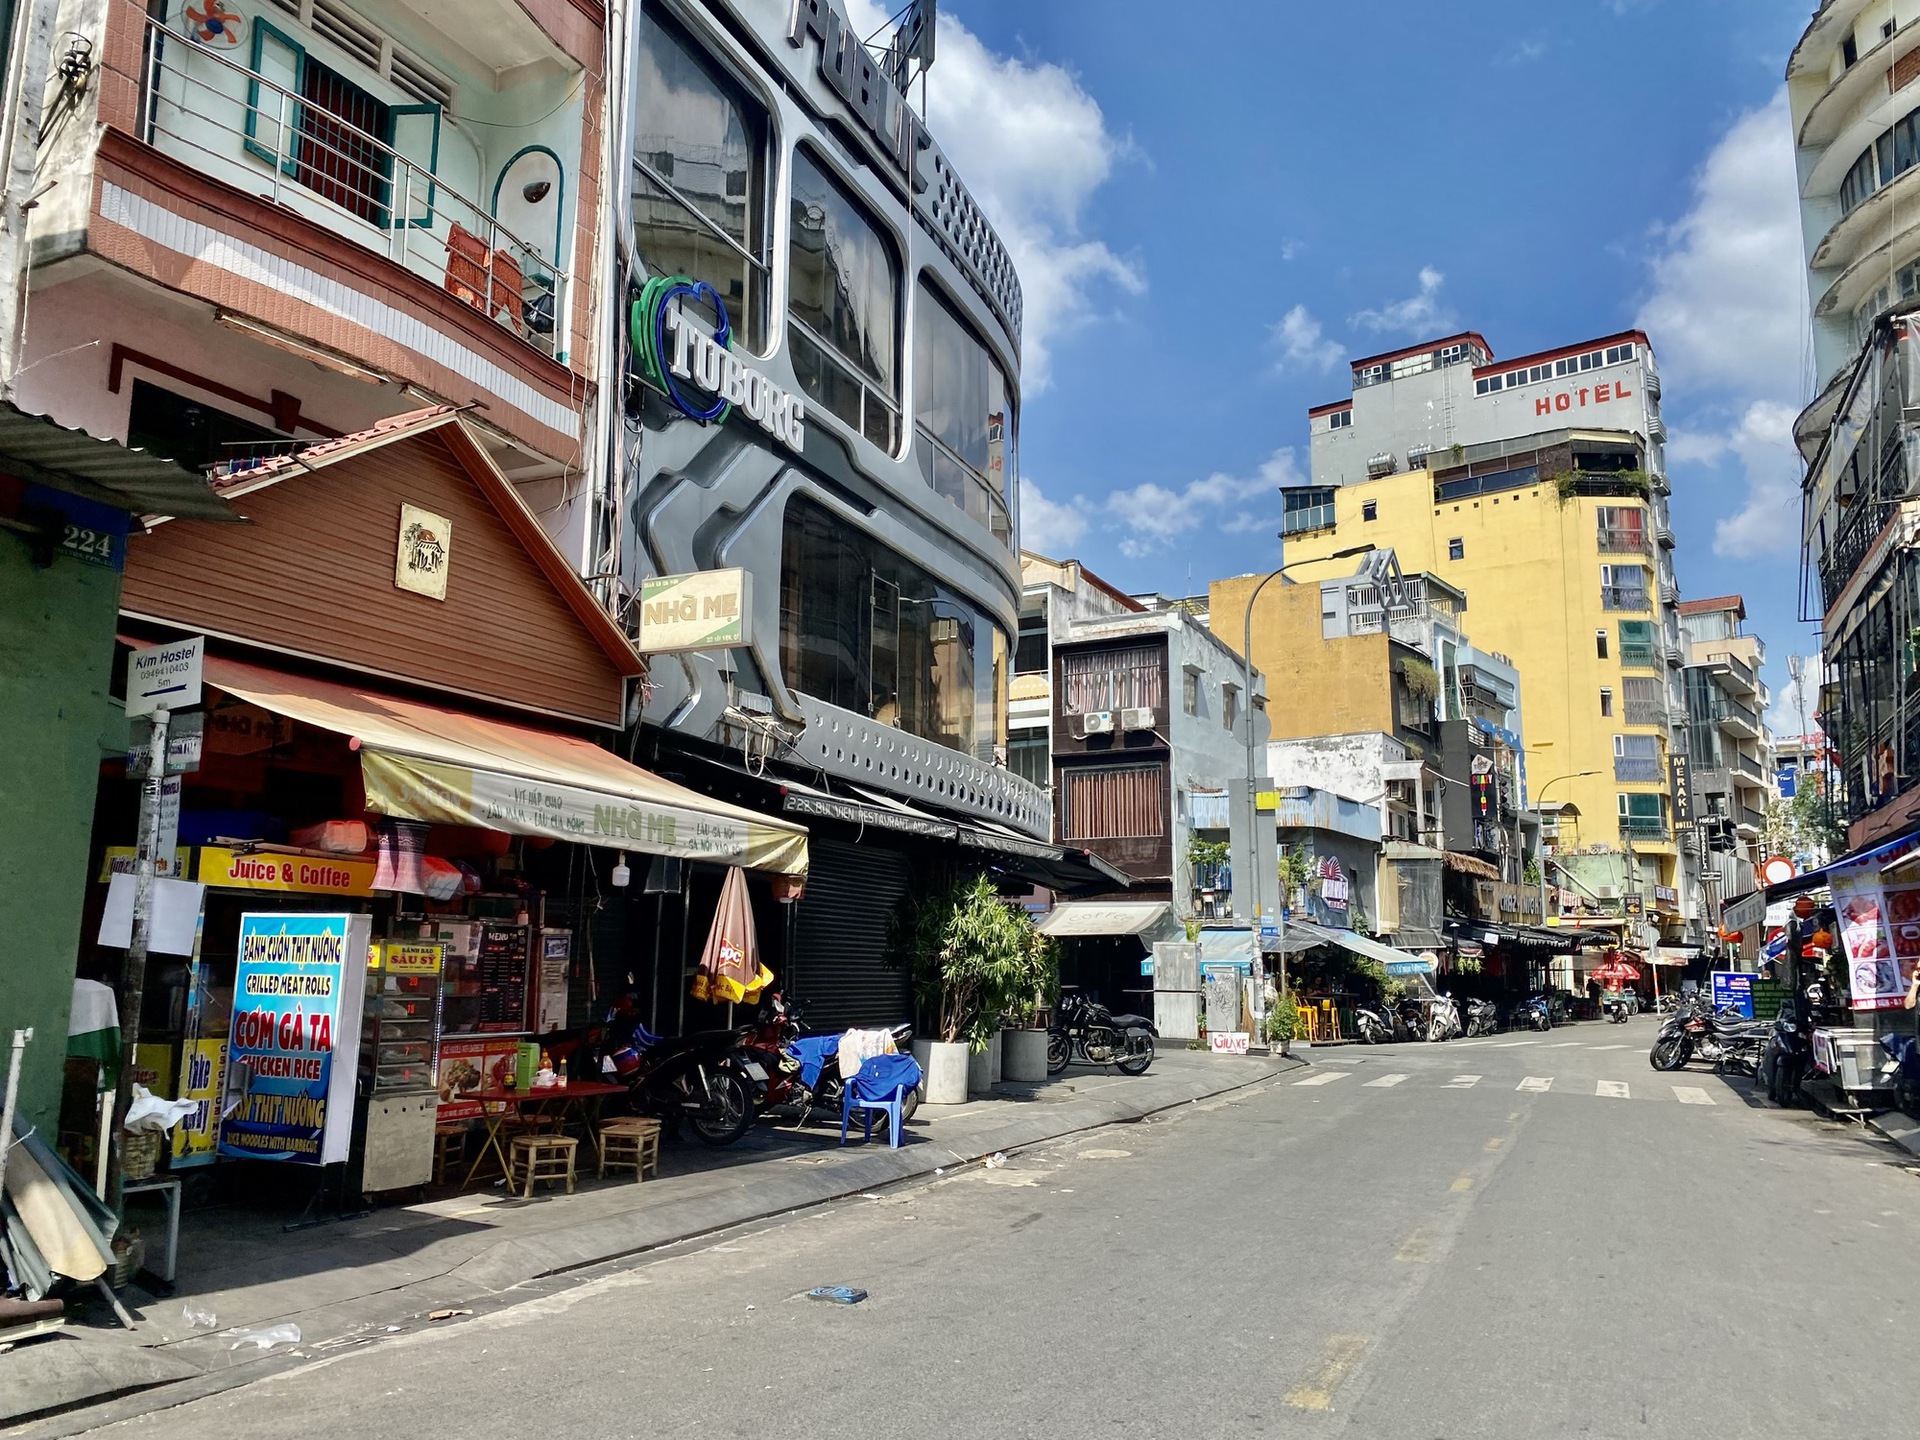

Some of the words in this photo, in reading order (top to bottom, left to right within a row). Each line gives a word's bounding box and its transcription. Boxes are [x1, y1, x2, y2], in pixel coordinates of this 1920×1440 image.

[666, 306, 805, 452] TUBORG
[1536, 380, 1632, 416] HOTEL
[63, 526, 110, 557] 224
[136, 655, 157, 670] Kim
[160, 645, 196, 664] Hostel
[1673, 757, 1688, 817] MERAKI
[859, 809, 909, 830] RESTAURANT
[229, 858, 276, 880] Juice
[281, 863, 293, 883] &
[300, 865, 350, 887] Coffee
[488, 932, 509, 941] MENU
[291, 936, 311, 969] THỊT
[247, 974, 279, 994] GRILLED
[280, 974, 304, 994] MEAT
[305, 976, 331, 995] ROLLS
[235, 1005, 275, 1049] CƠM
[279, 1003, 303, 1050] GÀ
[309, 1014, 331, 1052] TA
[188, 1054, 211, 1089] Take
[294, 1058, 321, 1079] RICE
[255, 1095, 282, 1130] THỊT
[241, 1133, 269, 1148] NOODLES
[269, 1135, 286, 1150] WITH
[286, 1137, 318, 1153] BARBECUE
